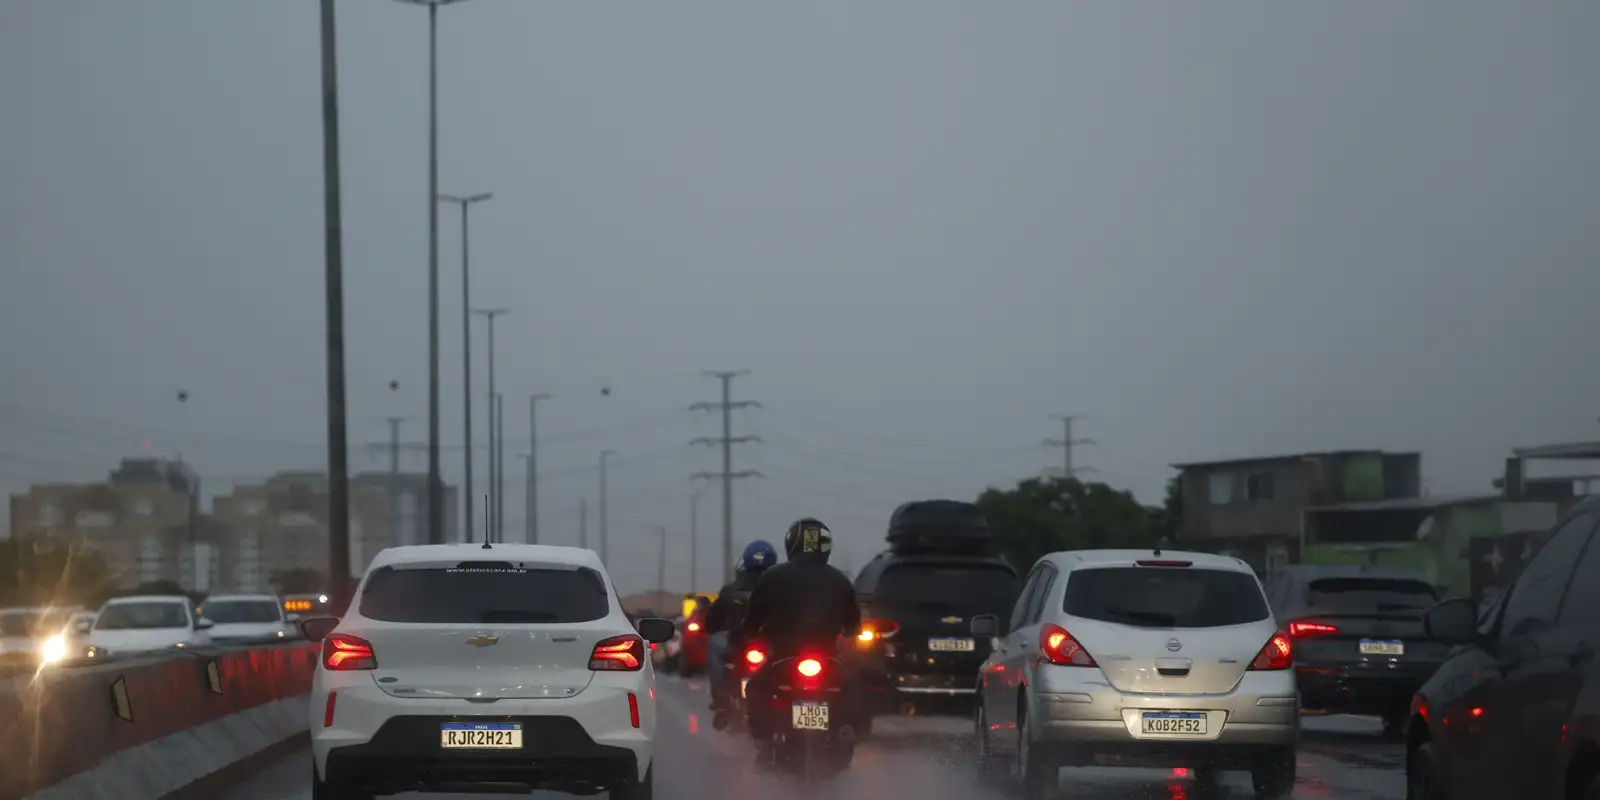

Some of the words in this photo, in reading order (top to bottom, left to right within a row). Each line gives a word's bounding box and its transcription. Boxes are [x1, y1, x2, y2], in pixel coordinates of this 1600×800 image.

[797, 716, 824, 727] 4D59
[1148, 719, 1200, 731] KOB2F52
[448, 731, 513, 745] RJR2H21
